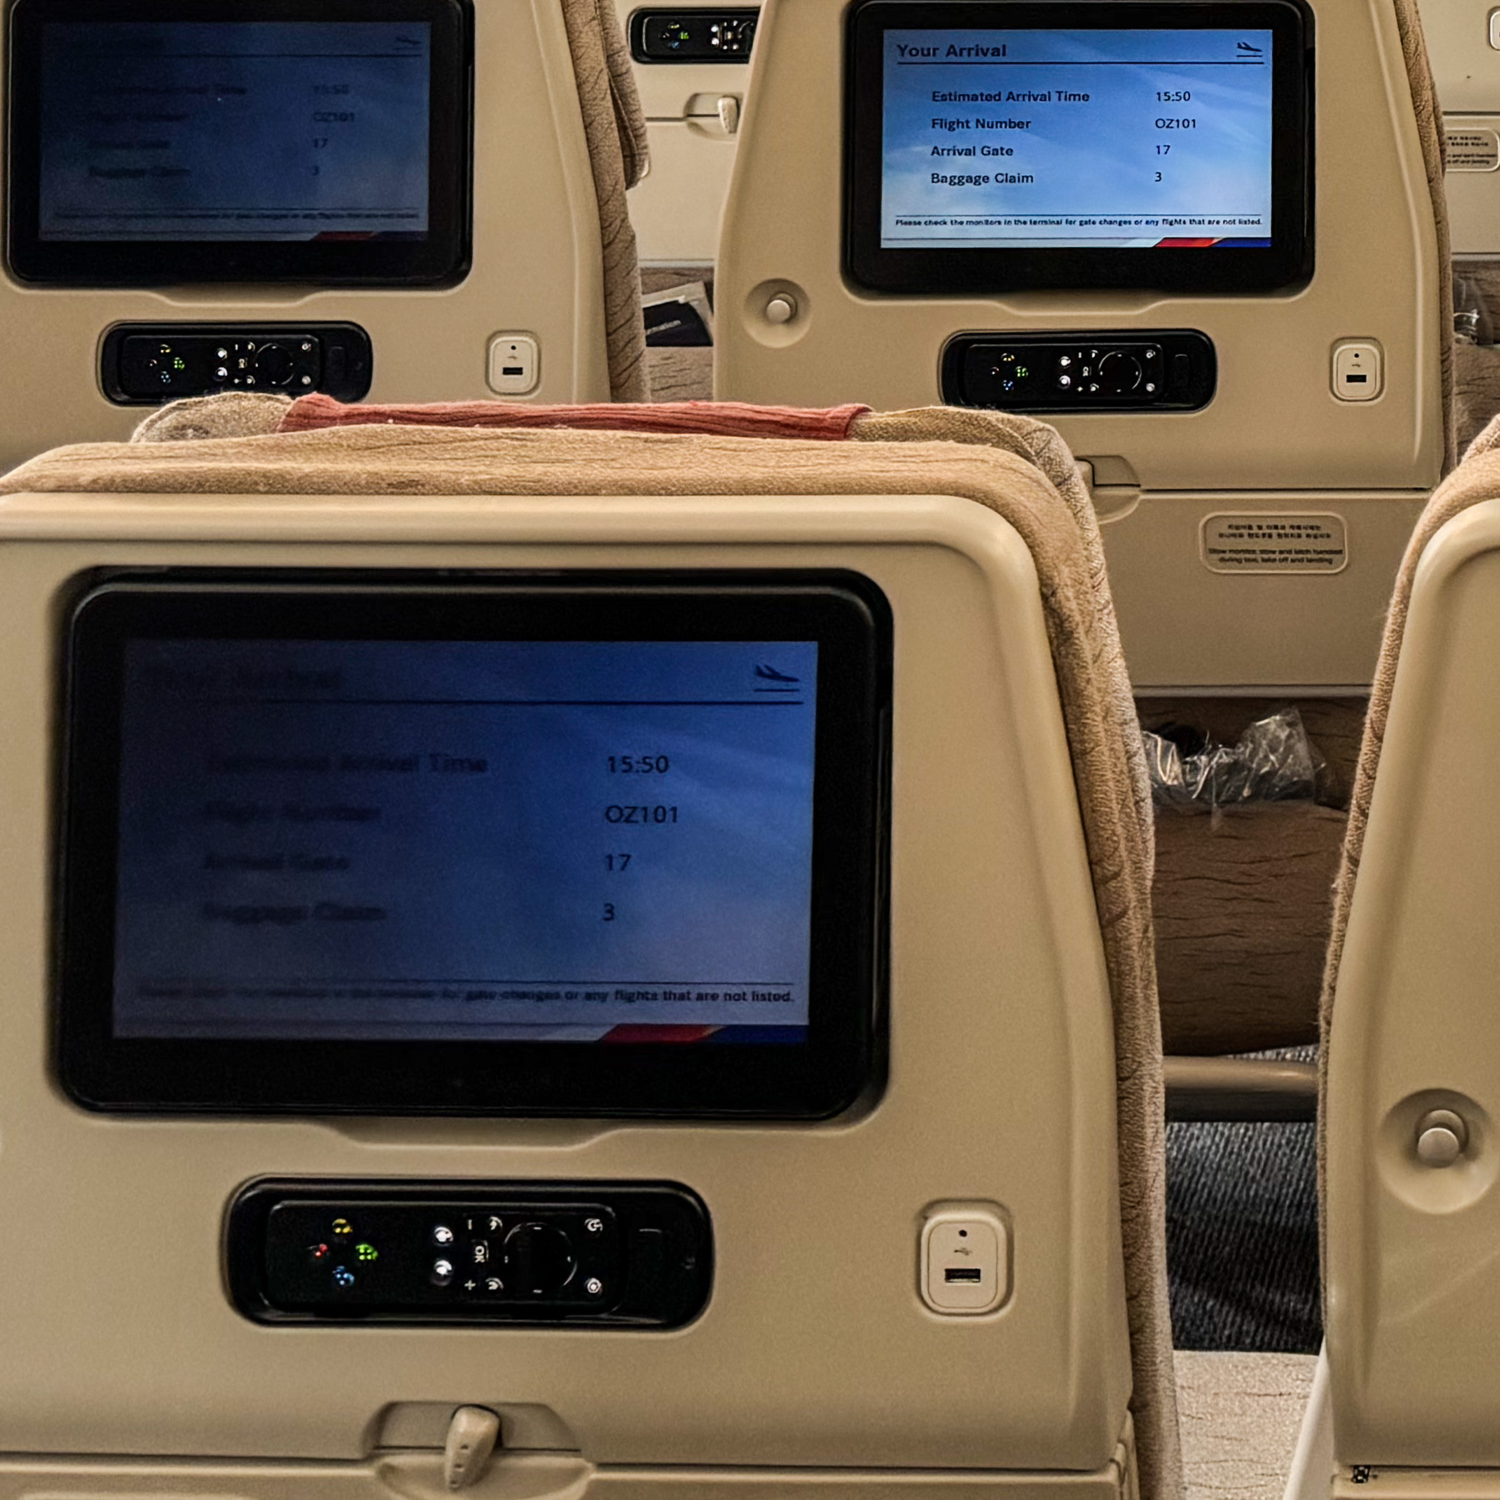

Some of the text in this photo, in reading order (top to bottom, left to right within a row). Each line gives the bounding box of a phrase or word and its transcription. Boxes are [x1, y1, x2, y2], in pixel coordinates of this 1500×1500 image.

[896, 43, 1006, 57] Your Arrival
[931, 90, 1191, 102] Estimated Arrival Time 15:50
[931, 116, 1196, 132] Flight Number OZ101
[930, 144, 1170, 156] Arrival Gate 17
[930, 171, 1162, 186] Baggage Claim 3
[606, 754, 670, 775] 15:50
[605, 804, 679, 824] OZ101
[605, 853, 632, 872] 17
[602, 902, 616, 922] 3
